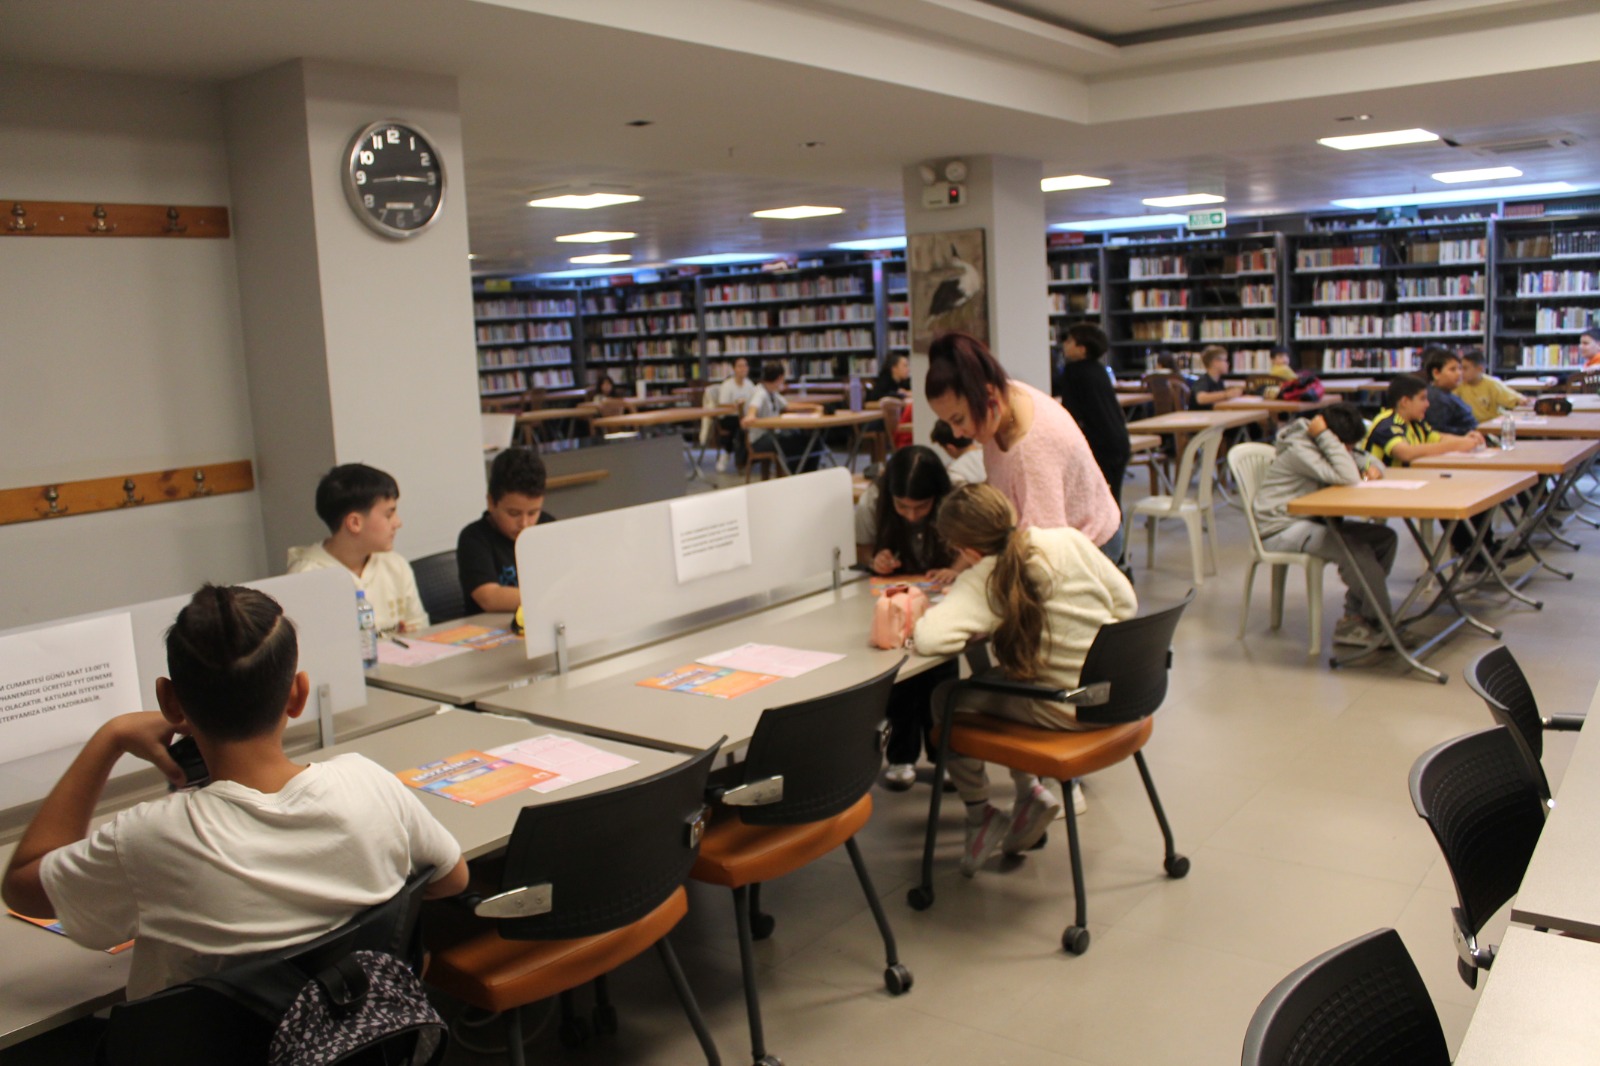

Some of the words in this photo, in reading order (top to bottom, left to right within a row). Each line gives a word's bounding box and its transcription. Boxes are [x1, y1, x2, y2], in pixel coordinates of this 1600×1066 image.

[372, 135, 383, 150] 11
[387, 129, 400, 144] 12
[409, 136, 415, 151] 1
[360, 150, 375, 165] 10
[420, 152, 431, 166] 2
[355, 170, 367, 185] 9
[426, 171, 436, 185] 3
[364, 194, 375, 208] 8
[423, 195, 434, 208] 4
[379, 208, 388, 221] 7
[396, 210, 405, 227] 6
[412, 208, 422, 222] 5
[66, 667, 83, 676] SAAT
[86, 672, 113, 683] DENEME
